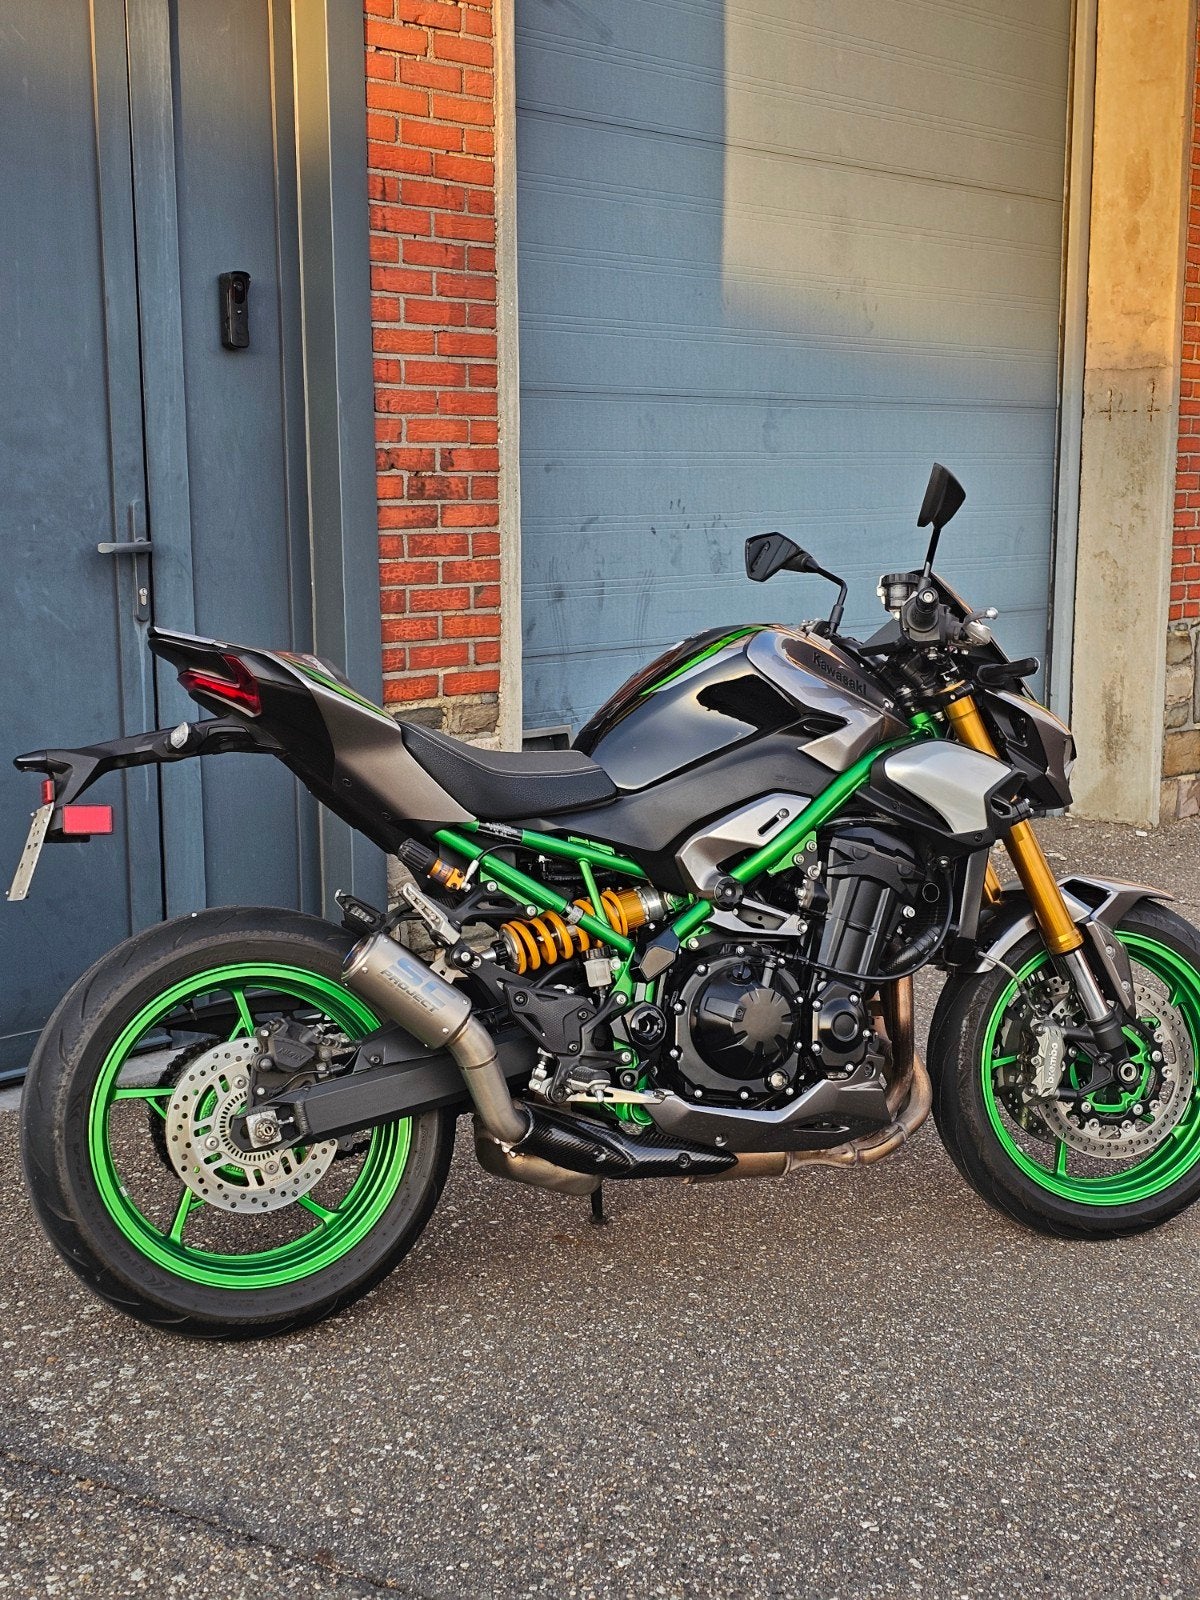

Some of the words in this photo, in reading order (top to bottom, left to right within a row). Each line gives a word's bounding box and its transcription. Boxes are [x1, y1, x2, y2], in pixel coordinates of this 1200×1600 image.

[813, 650, 867, 695] Kawasaki
[380, 969, 440, 1013] PROJECT
[1046, 1042, 1058, 1084] brembo
